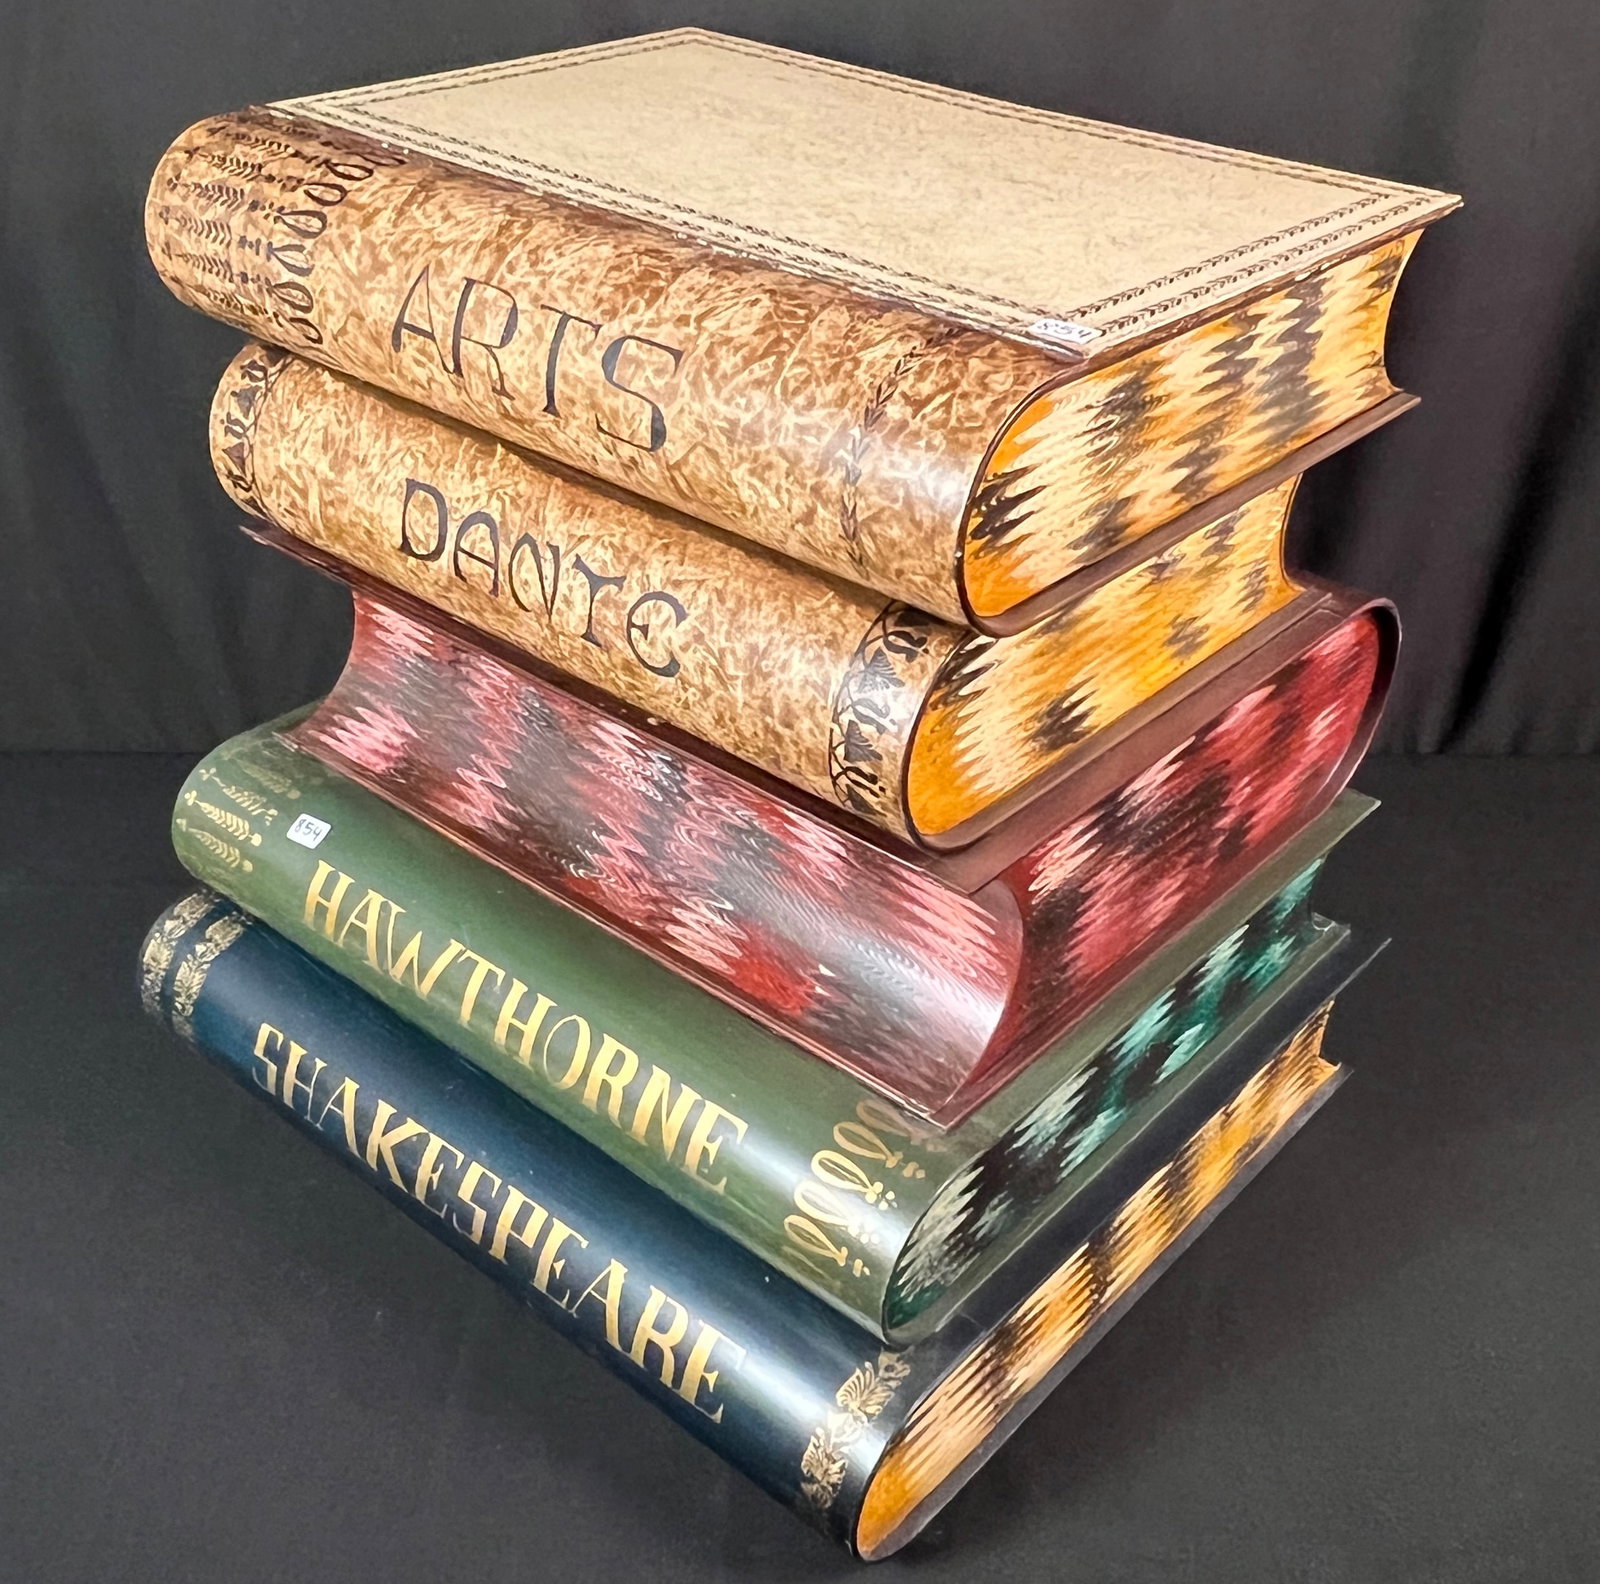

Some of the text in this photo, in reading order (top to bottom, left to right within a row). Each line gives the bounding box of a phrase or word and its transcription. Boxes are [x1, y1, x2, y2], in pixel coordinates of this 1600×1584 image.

[392, 265, 683, 452] ARTS
[400, 478, 688, 677] DANTE
[294, 818, 323, 842] 854
[303, 859, 749, 1194] HAWTHORNE
[251, 1022, 748, 1424] SHAKESPEARE
